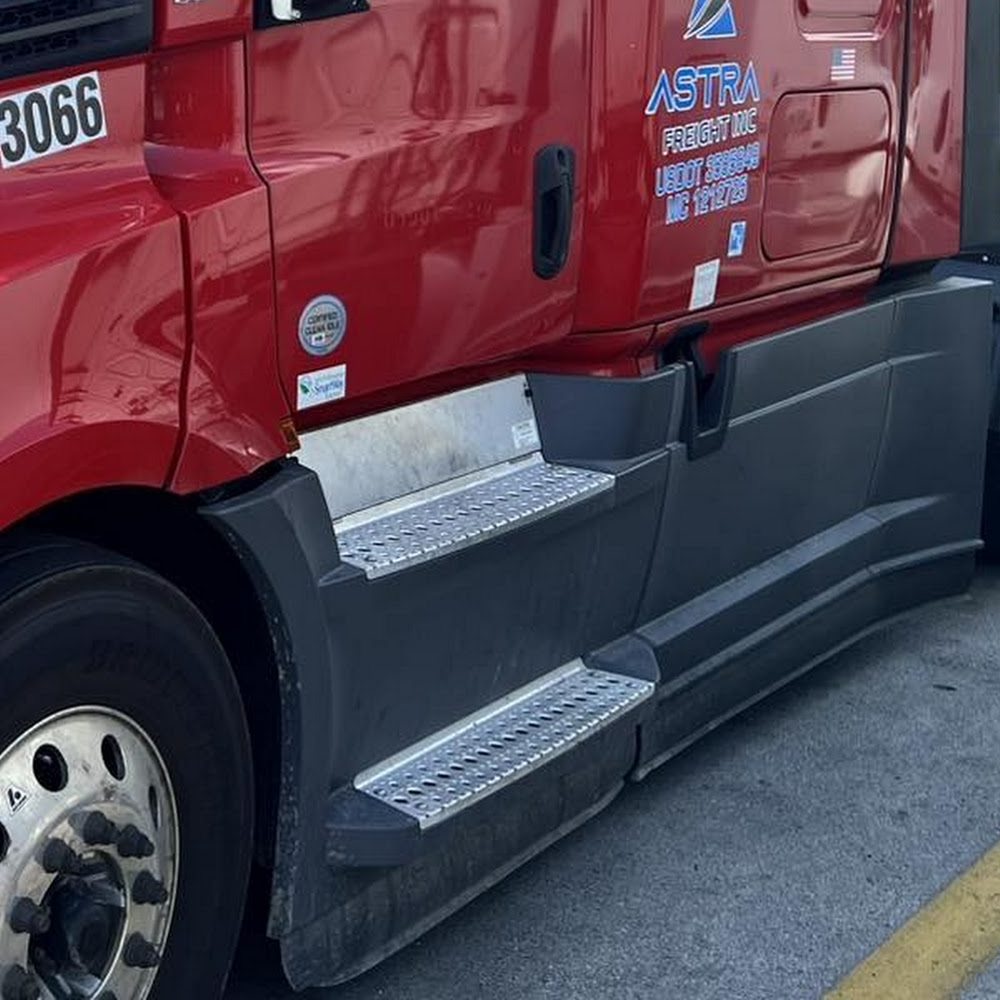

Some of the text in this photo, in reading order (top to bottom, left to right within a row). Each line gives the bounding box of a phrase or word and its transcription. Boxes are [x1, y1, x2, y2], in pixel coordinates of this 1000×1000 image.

[644, 60, 760, 115] ASTRA
[662, 107, 757, 155] FREIGHT INC
[655, 157, 704, 197] USDOT
